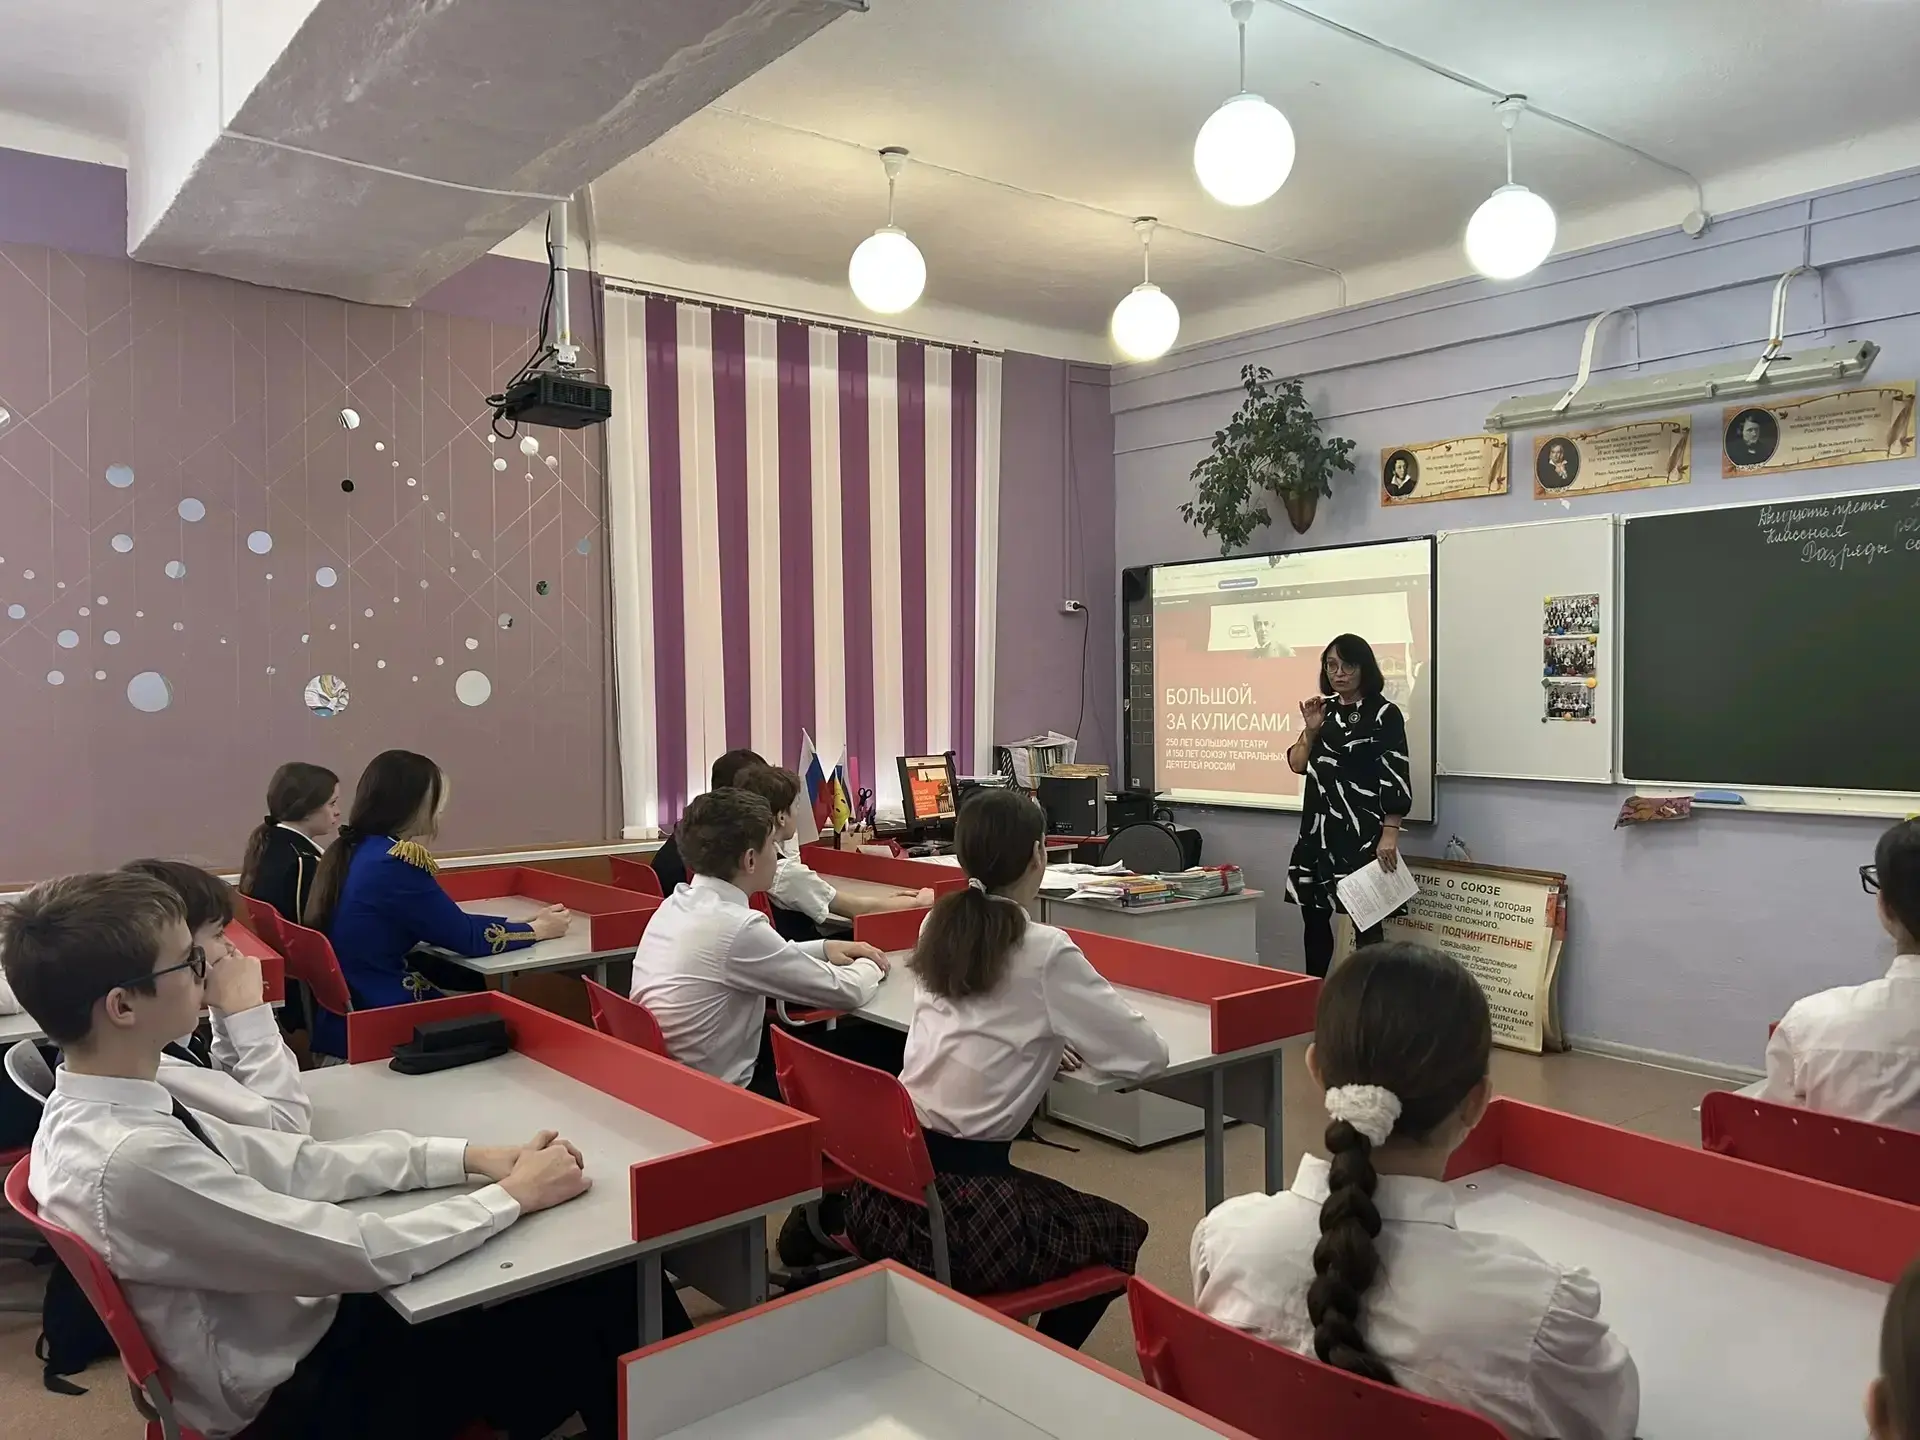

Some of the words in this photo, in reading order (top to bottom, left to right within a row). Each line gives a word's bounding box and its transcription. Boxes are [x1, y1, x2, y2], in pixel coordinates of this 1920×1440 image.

[1801, 540, 1893, 570] Разряды
[1166, 683, 1257, 705] БОЛЬШОЙ.
[1166, 713, 1187, 731] ЗА
[1191, 713, 1290, 732] КУЛИСАМИ
[1165, 738, 1179, 746] 250
[1179, 738, 1194, 747] ЛЕТ
[1195, 739, 1238, 748] БОЛЬШОМУ
[1239, 740, 1269, 749] ТЕАТРУ
[1184, 750, 1198, 758] ЛЕТ
[1200, 750, 1227, 759] СОЮЗУ
[1229, 751, 1286, 761] ТЕАТРАЛЬНЫХ
[1165, 760, 1202, 770] ДЕЯТЕЛЕЙ
[1203, 761, 1236, 771] РОССИИ
[1446, 879, 1455, 888] О
[1460, 881, 1501, 896] СОЮЗЕ
[1440, 890, 1465, 902] часть
[1493, 900, 1532, 913] которая
[1407, 898, 1452, 911] нородные
[1454, 904, 1483, 916] члены
[1494, 911, 1535, 925] простые
[1418, 908, 1452, 921] составе
[1454, 915, 1500, 930] сложного.
[1385, 917, 1434, 931] ИТЕЛЬНЫЕ
[1441, 925, 1533, 950] ПОДЧИНИТЕЛЬНЫЕ
[1469, 963, 1502, 975] сложного
[1471, 955, 1518, 970] предложения
[1497, 987, 1512, 996] мы
[1512, 989, 1535, 1000] едем
[1490, 1012, 1534, 1027] ительнее
